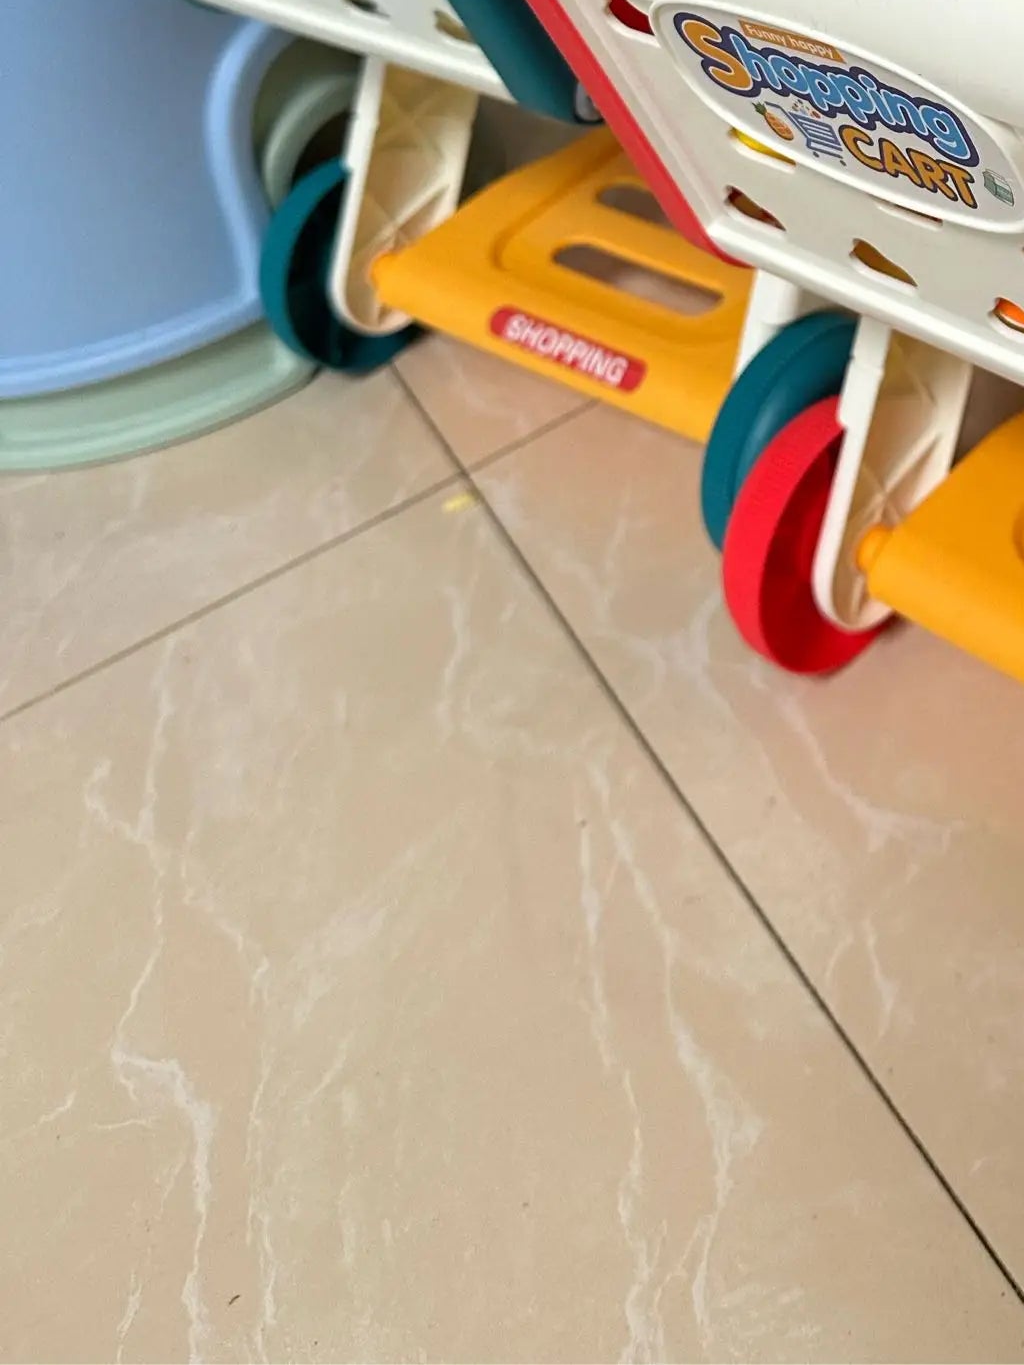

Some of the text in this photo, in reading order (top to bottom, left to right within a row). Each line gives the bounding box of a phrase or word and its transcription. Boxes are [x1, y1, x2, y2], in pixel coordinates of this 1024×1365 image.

[744, 23, 835, 60] Funny happy
[674, 12, 979, 167] Shopping
[838, 124, 979, 210] CART
[505, 312, 630, 387] SHOPPING
